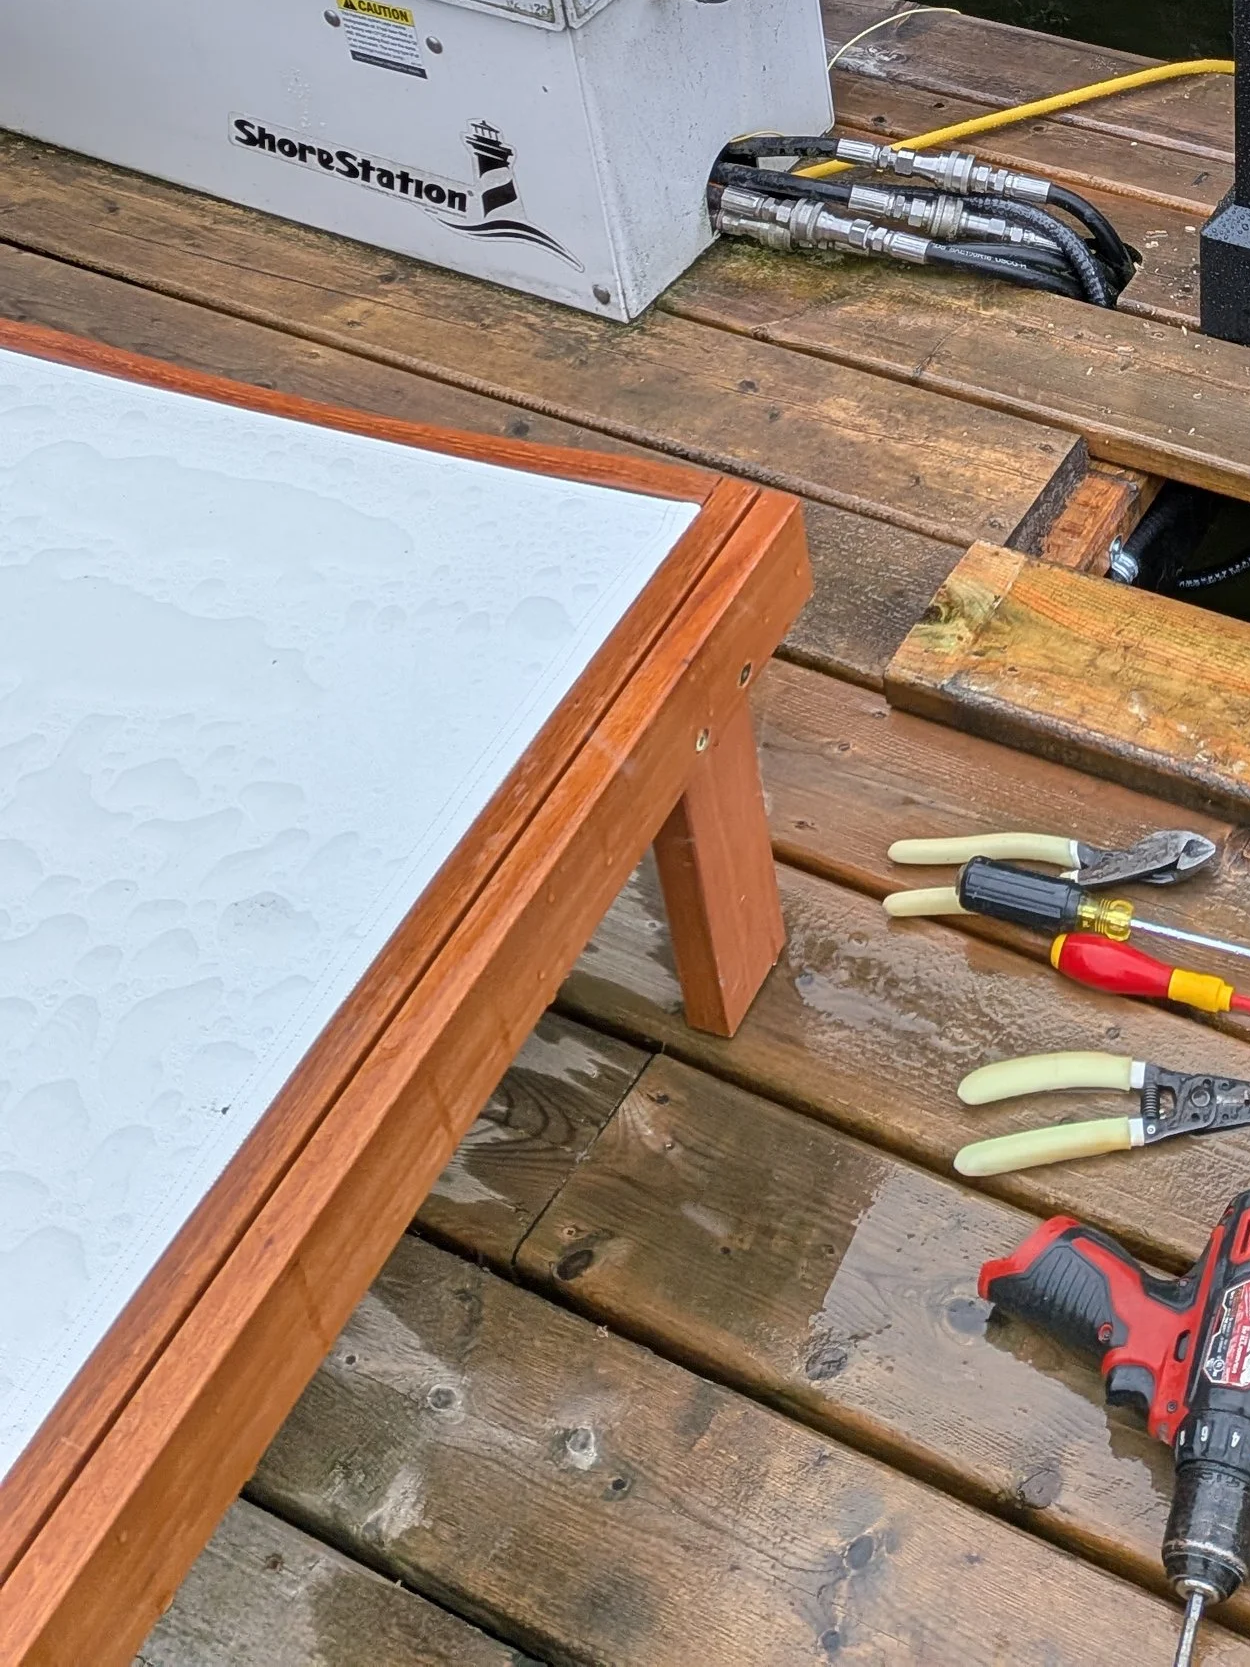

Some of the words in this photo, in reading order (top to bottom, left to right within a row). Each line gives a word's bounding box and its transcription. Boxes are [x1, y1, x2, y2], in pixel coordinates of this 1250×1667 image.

[358, 0, 409, 23] CAUTION
[234, 119, 468, 213] ShoreStation
[1200, 1426, 1209, 1442] 6
[1231, 1431, 1241, 1447] 4
